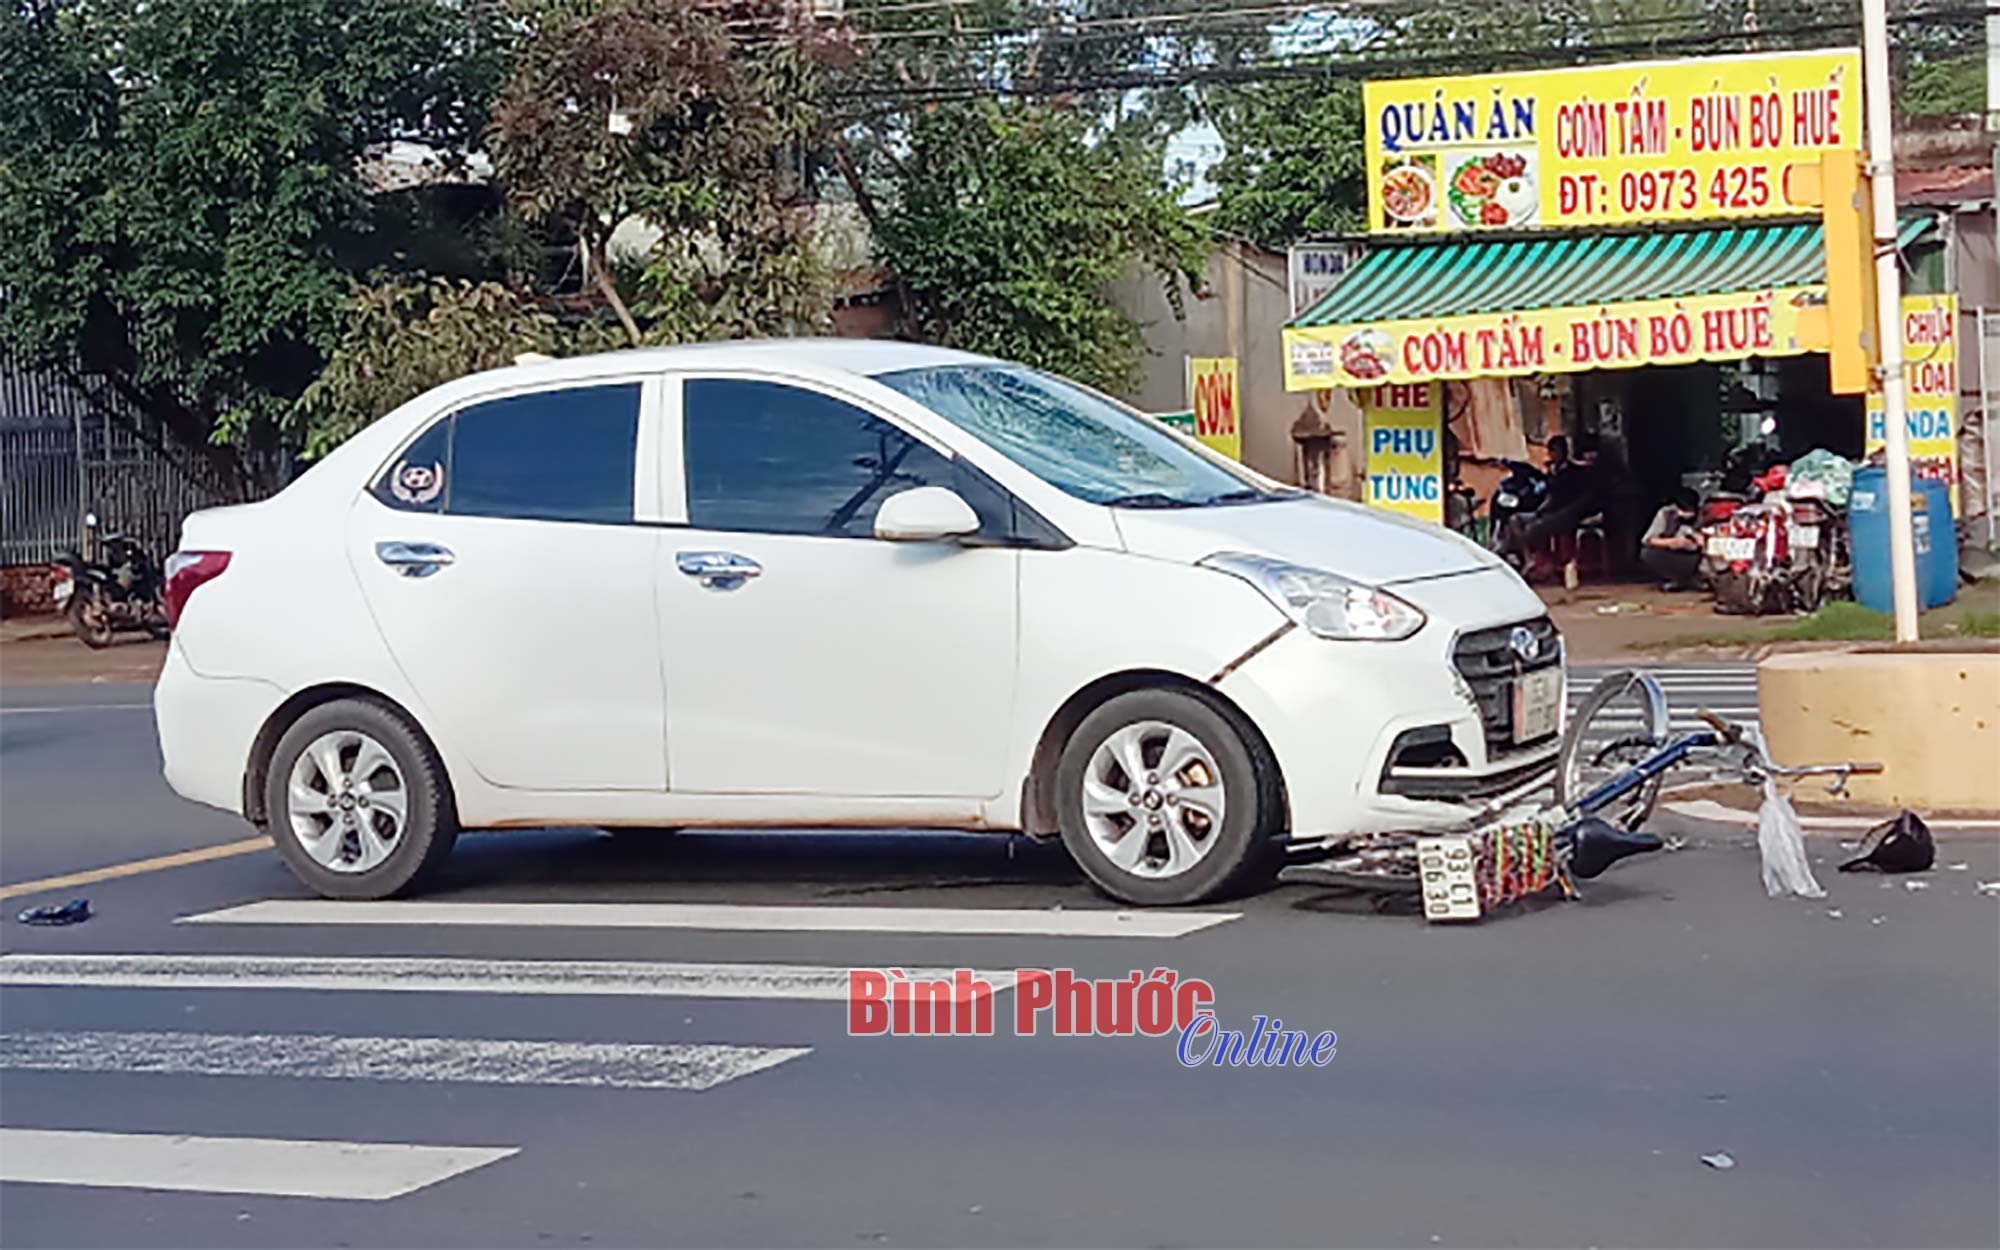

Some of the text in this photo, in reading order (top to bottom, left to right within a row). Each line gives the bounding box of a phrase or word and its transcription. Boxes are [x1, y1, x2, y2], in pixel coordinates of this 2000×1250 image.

[1381, 87, 1536, 151] QUÁN ĂN
[1557, 94, 1606, 158] CƠM
[1614, 76, 1666, 155] TẤM
[1691, 80, 1741, 151] BÚN
[1750, 76, 1783, 148] BÒ
[1793, 65, 1844, 146] HUẾ
[1560, 175, 1608, 215] ĐT:
[1620, 168, 1698, 213] 0973
[1709, 166, 1769, 208] 425
[1403, 324, 1467, 374] CƠM
[1476, 314, 1544, 369] TẤM
[1570, 307, 1638, 363] BÚN
[1649, 301, 1692, 357] BÒ
[1702, 291, 1773, 352] HUẾ
[1373, 428, 1434, 459] PHỤ
[1871, 410, 1951, 438] HNDA
[1370, 468, 1438, 501] TÙNG
